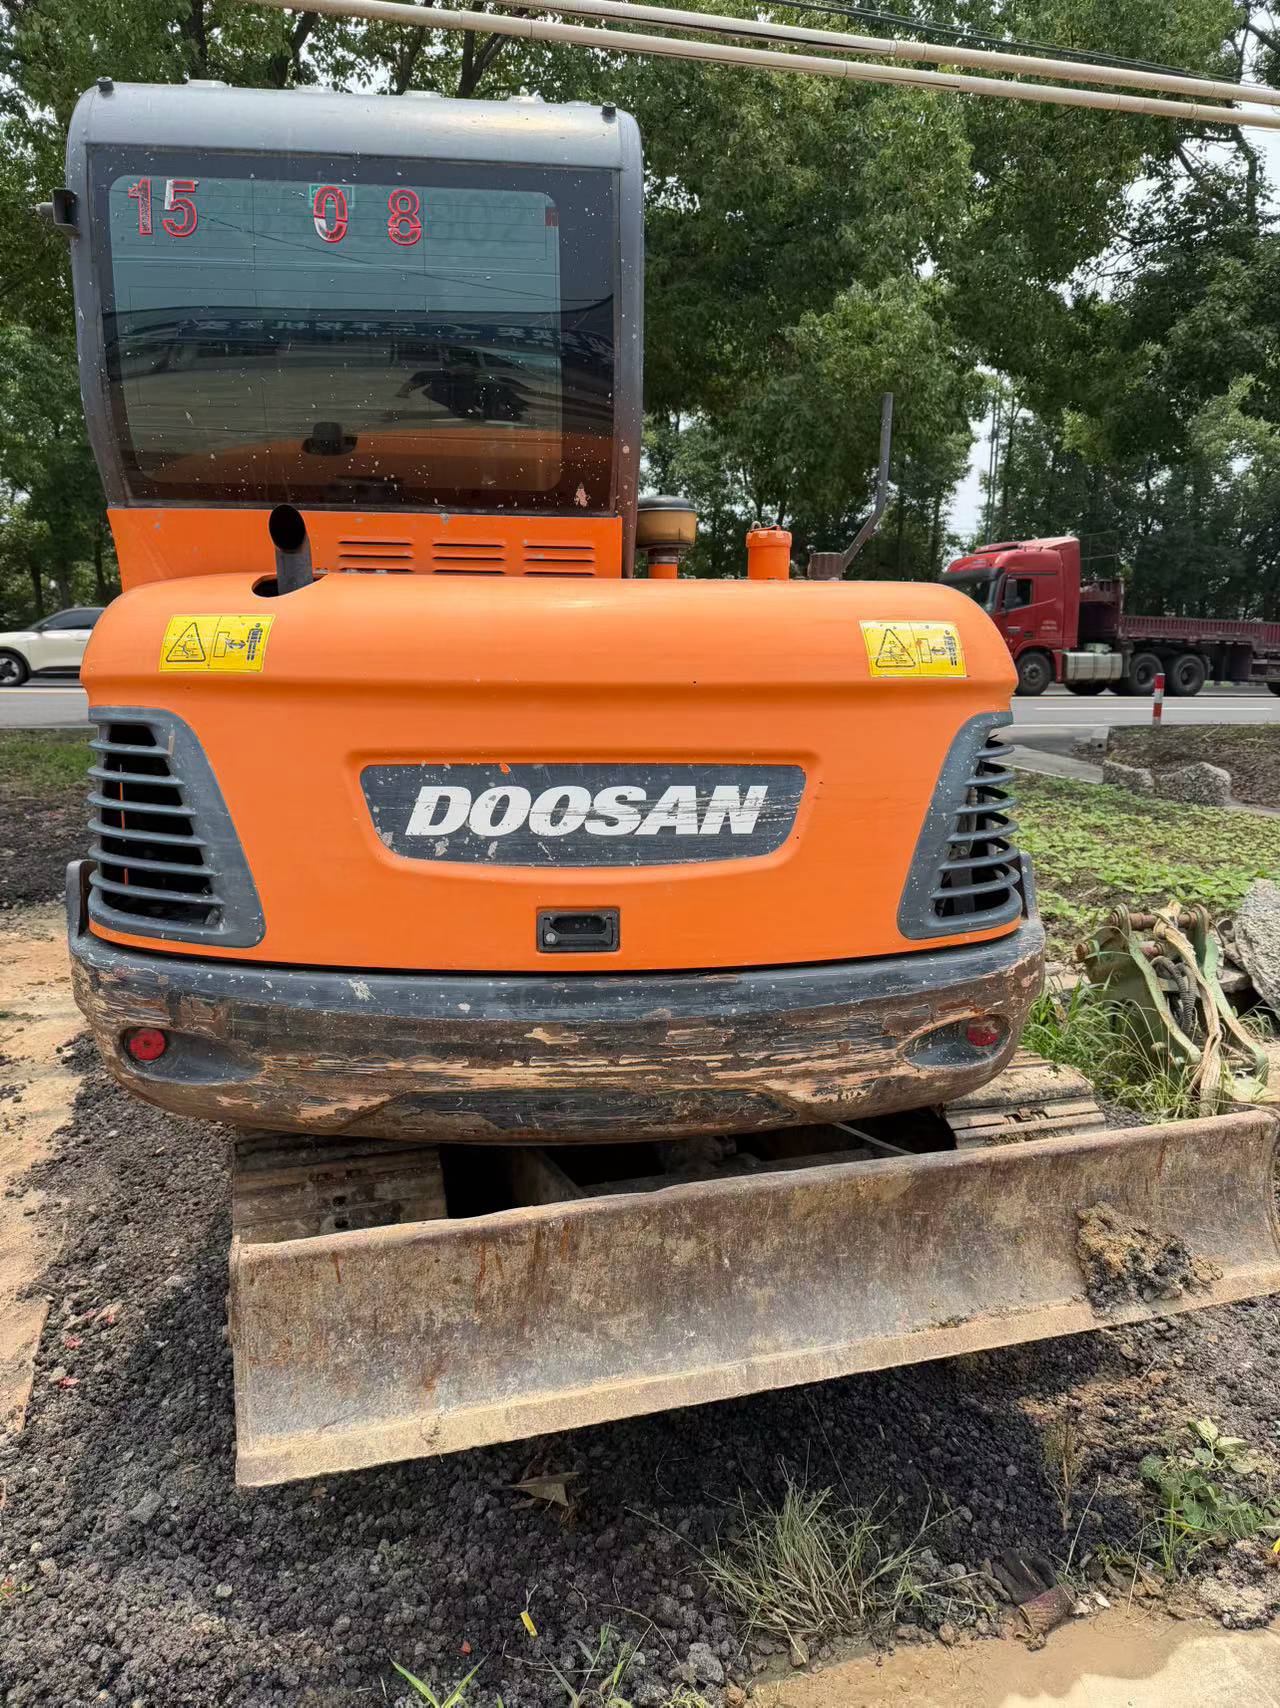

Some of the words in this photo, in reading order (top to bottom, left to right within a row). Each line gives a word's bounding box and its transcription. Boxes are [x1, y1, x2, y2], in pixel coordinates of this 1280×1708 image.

[128, 177, 198, 236] 15
[388, 189, 423, 246] 8
[404, 785, 769, 837] DOOSAN
